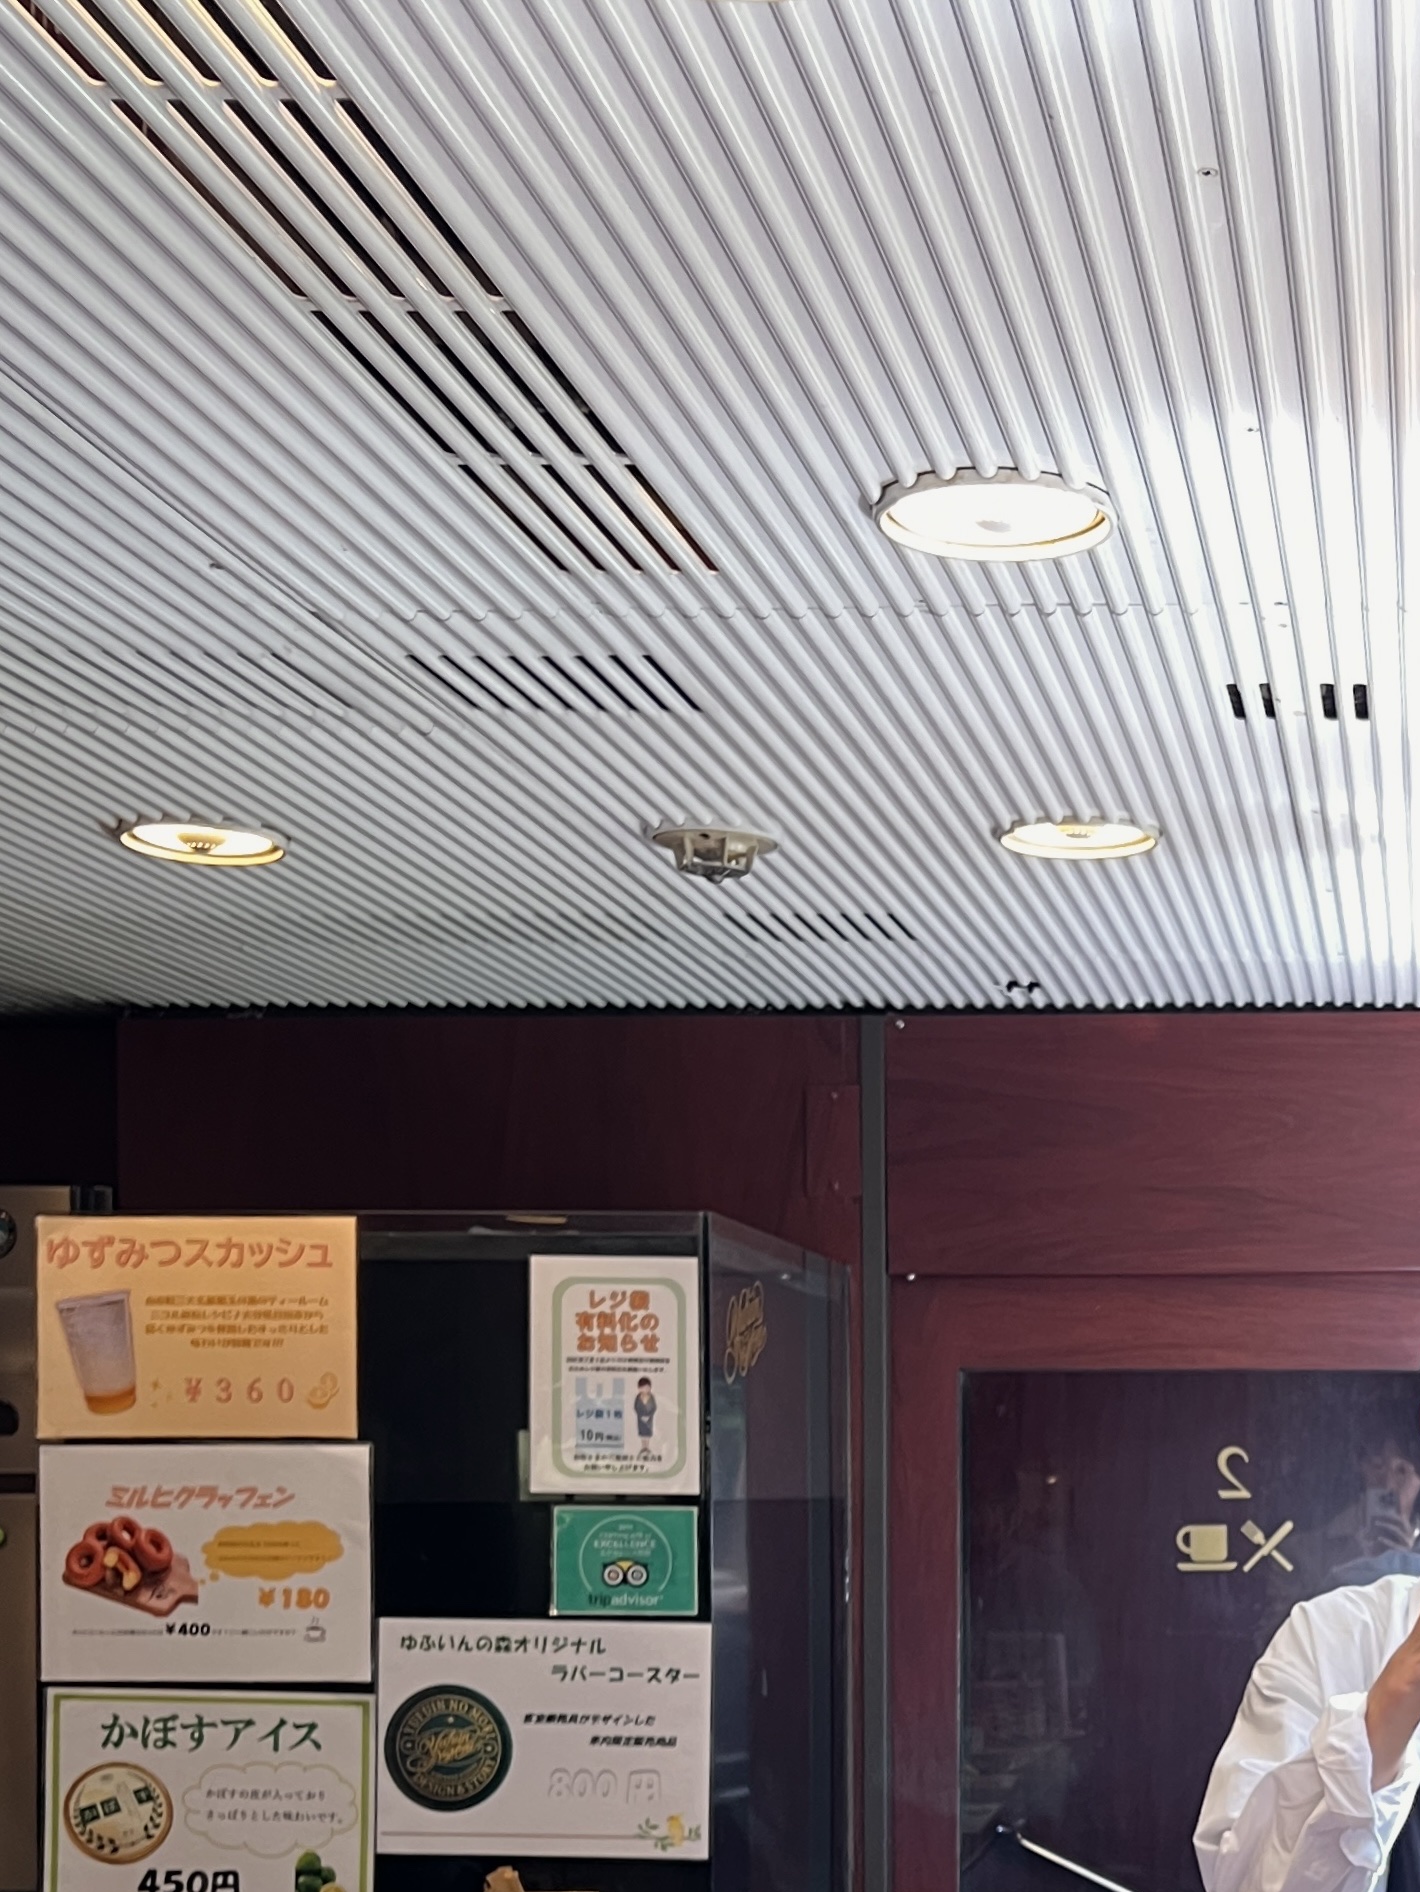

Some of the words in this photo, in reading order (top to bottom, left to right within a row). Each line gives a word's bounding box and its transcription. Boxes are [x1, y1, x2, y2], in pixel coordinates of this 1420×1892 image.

[45, 1235, 334, 1269] ゆずみつスカッシュ
[105, 1484, 296, 1510] ミルヒクラッフェン
[588, 1592, 660, 1608] tripadvisor
[165, 1622, 211, 1637] ¥400
[400, 1634, 607, 1655] ゆふいんの森オリジナル
[551, 1664, 700, 1685] ラバーコースター
[100, 1713, 322, 1752] かぼすアイス
